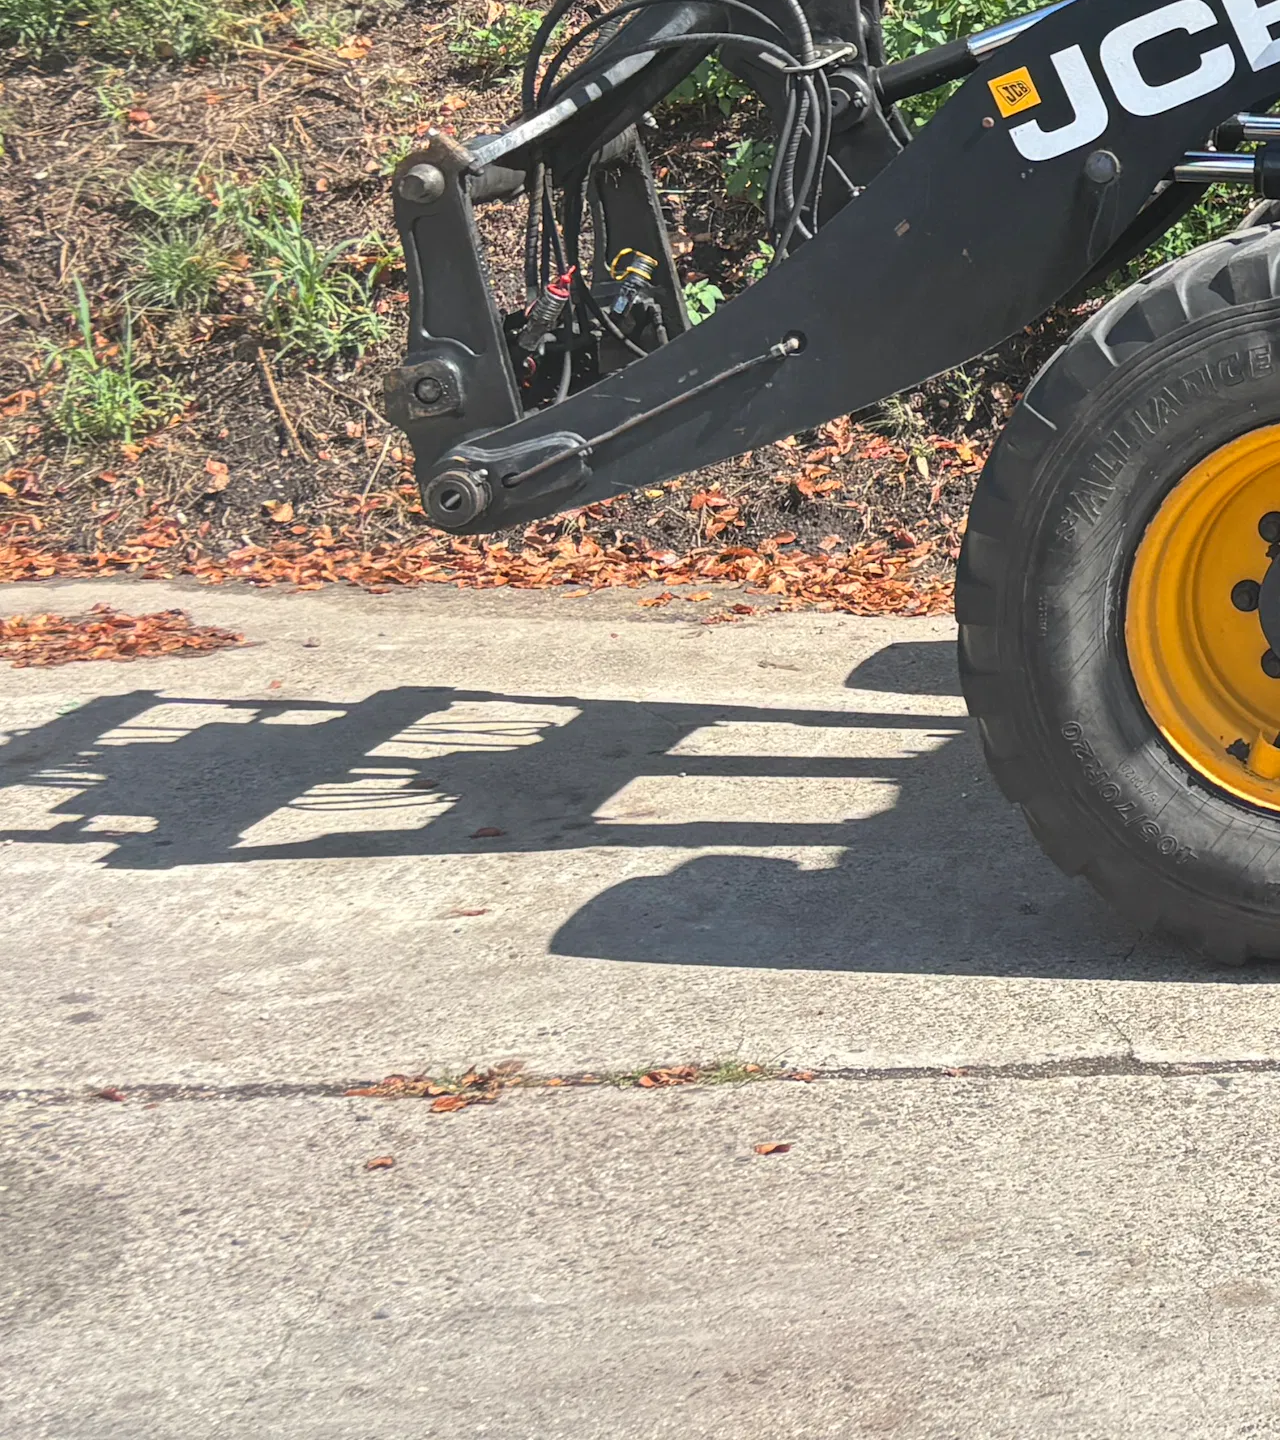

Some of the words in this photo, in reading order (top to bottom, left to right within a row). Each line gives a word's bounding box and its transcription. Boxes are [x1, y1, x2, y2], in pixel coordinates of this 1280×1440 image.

[1002, 82, 1028, 103] JCB
[1070, 343, 1274, 527] ALLIANCE
[1061, 721, 1198, 864] 405/70R20
